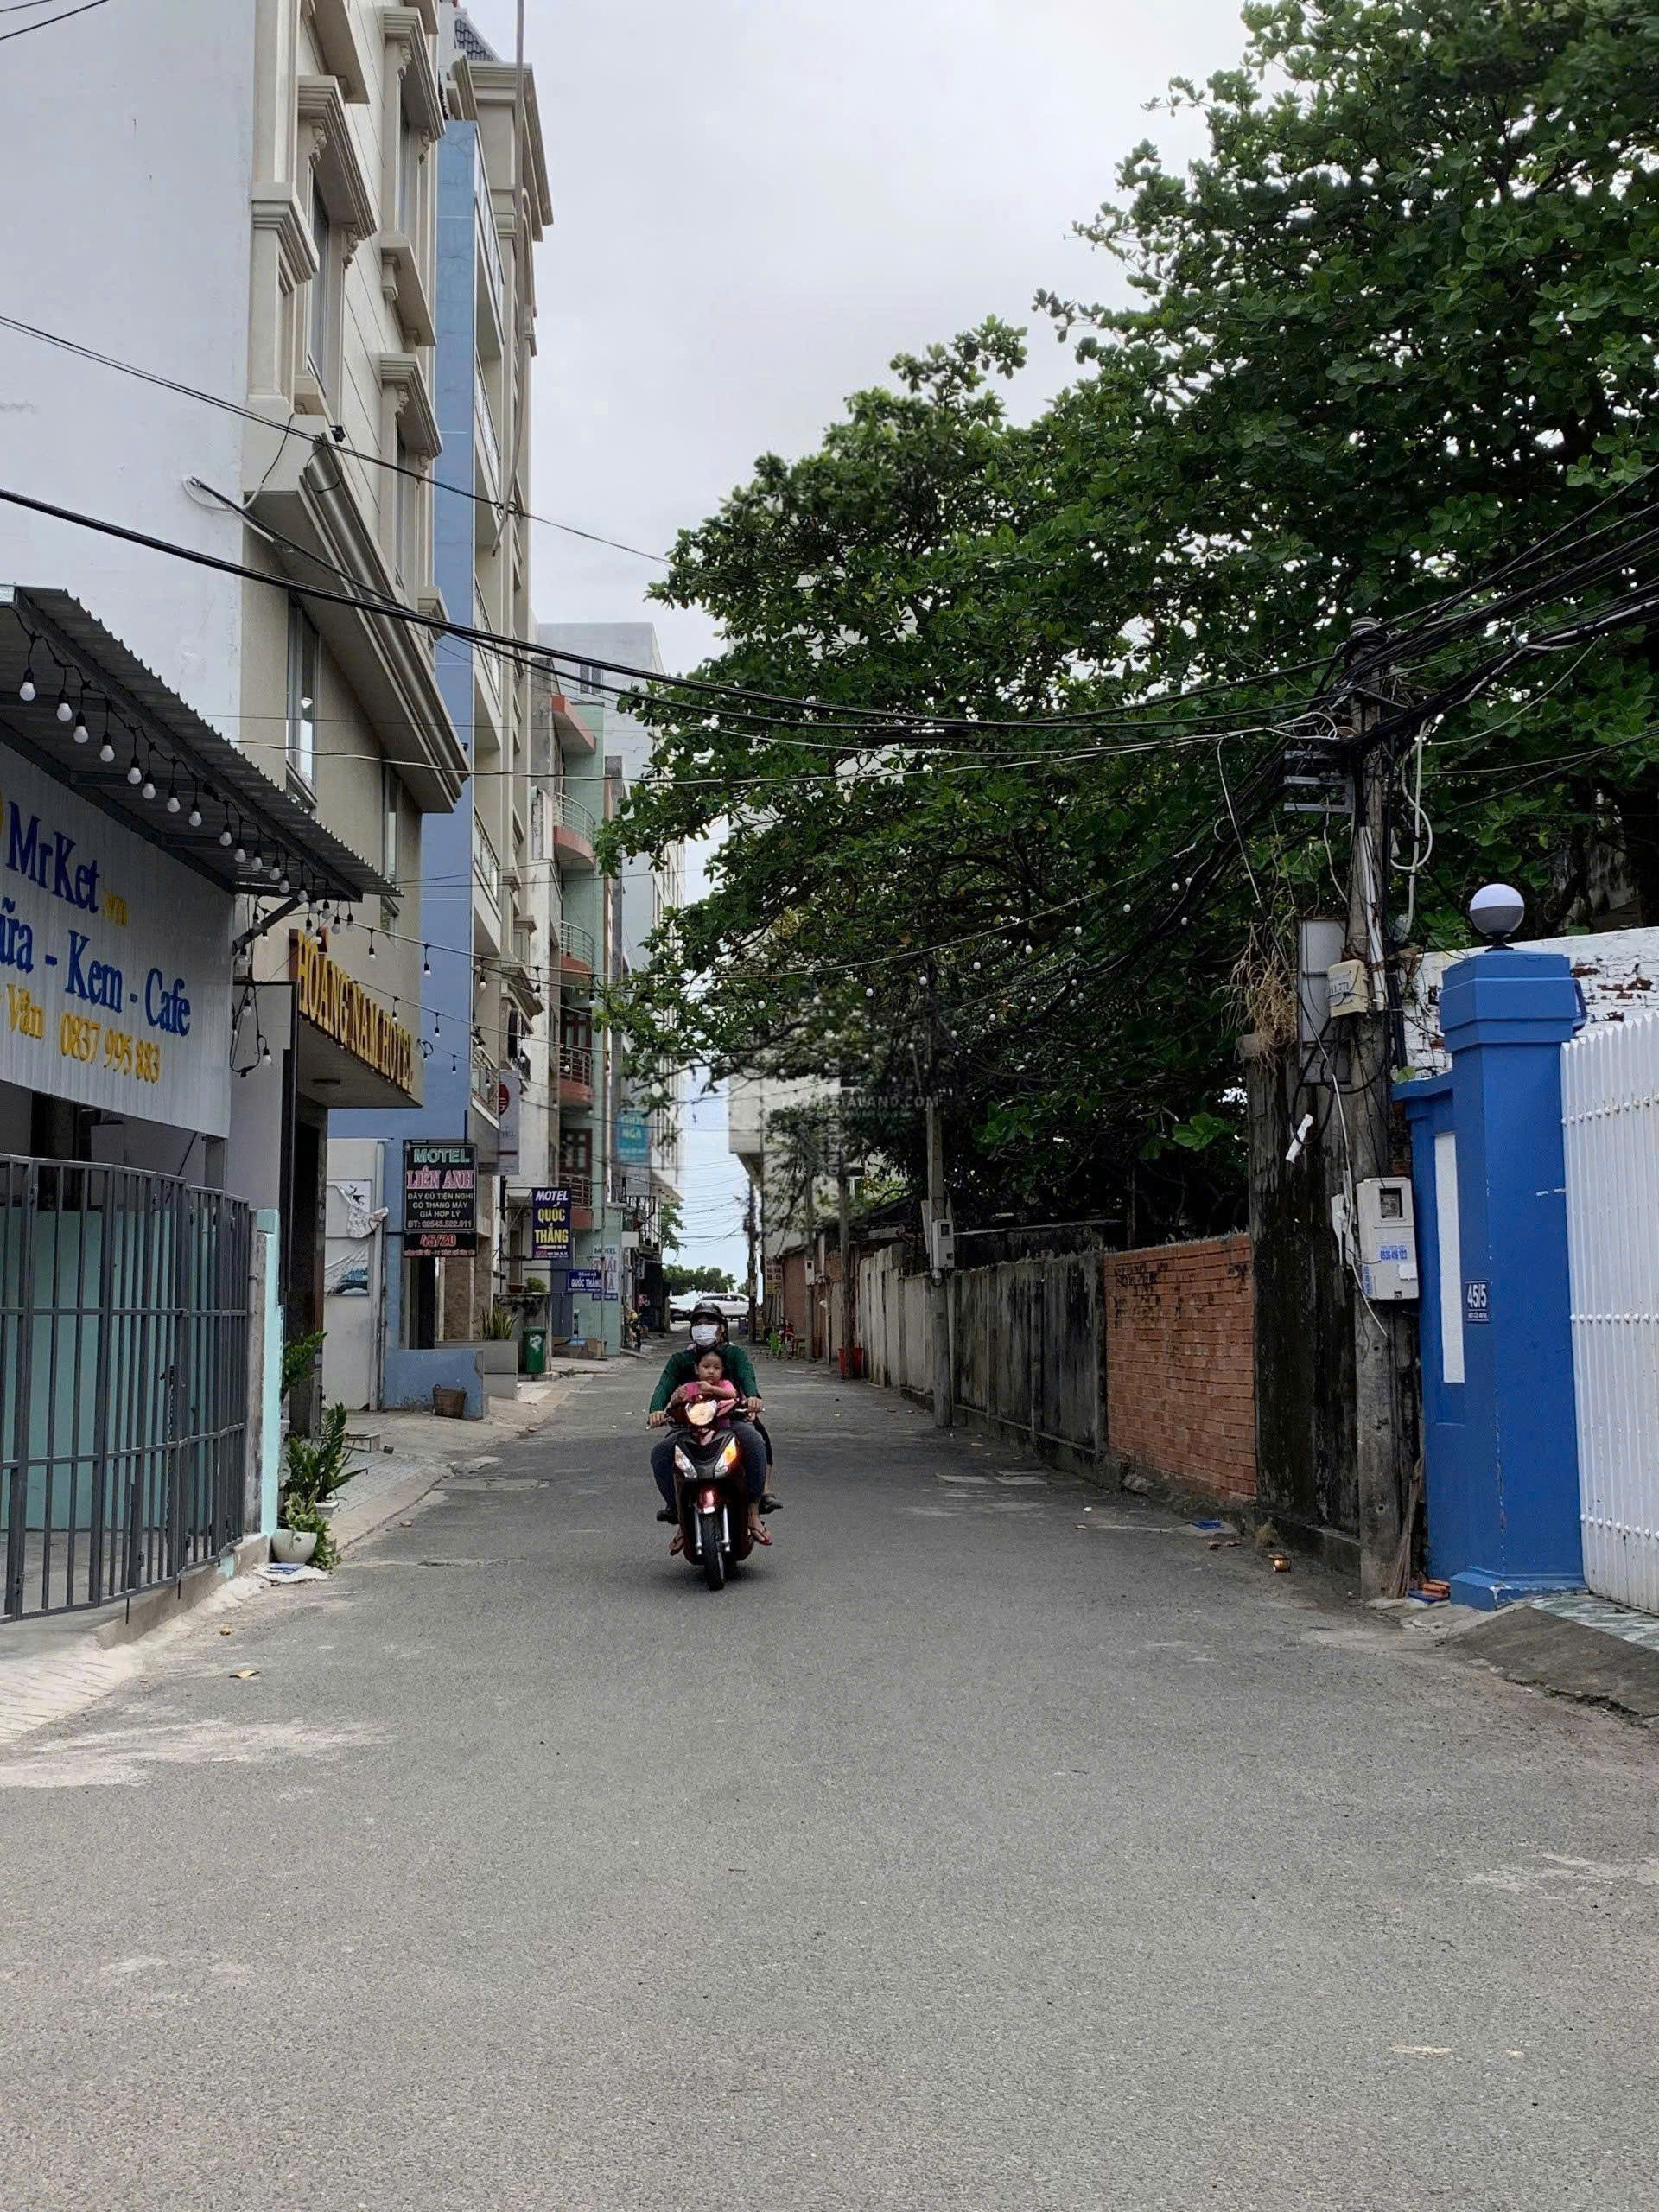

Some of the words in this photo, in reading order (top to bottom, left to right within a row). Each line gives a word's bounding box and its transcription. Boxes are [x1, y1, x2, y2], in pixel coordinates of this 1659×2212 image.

[0, 895, 35, 974] ữa
[65, 929, 123, 1014] Kem
[145, 967, 192, 1037] Cafe
[413, 1147, 470, 1163] MOTEL
[407, 1164, 441, 1189] LIÊN
[442, 1169, 474, 1189] ANH
[536, 1190, 568, 1201] MOTEL
[537, 1201, 566, 1223] QUỐC
[534, 1222, 569, 1243] THẮNG
[1467, 1283, 1487, 1308] 45/5
